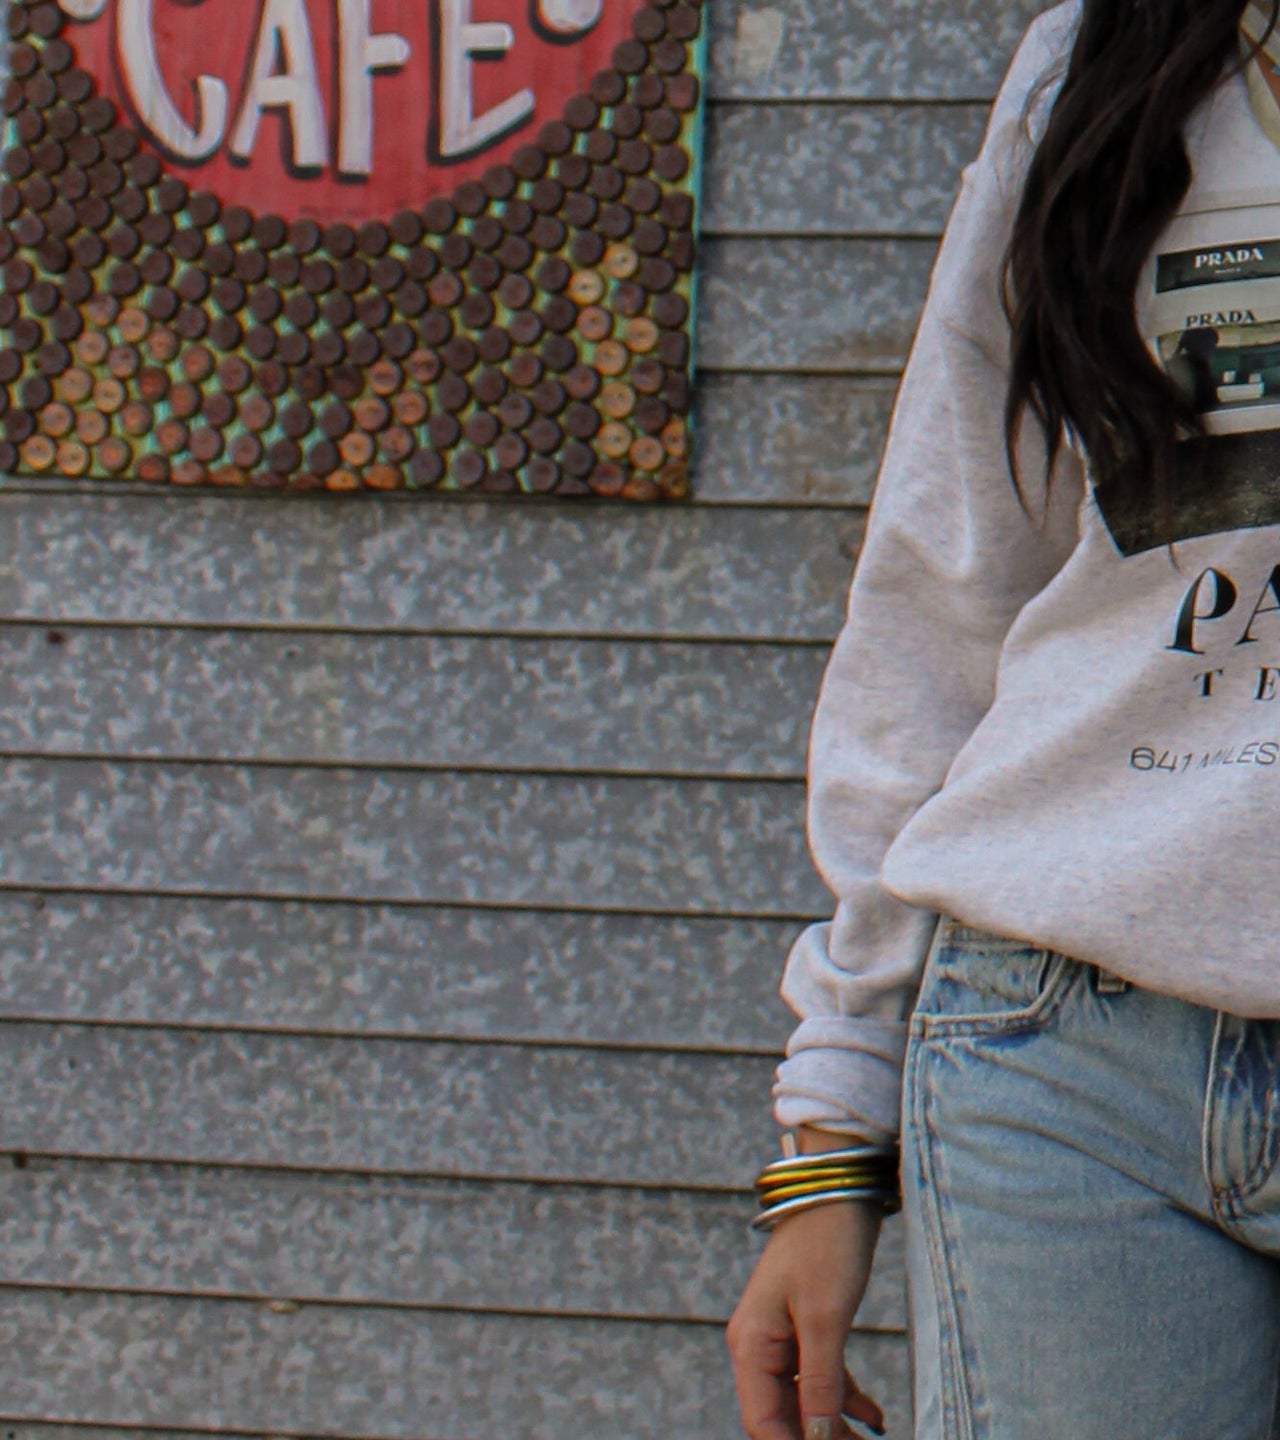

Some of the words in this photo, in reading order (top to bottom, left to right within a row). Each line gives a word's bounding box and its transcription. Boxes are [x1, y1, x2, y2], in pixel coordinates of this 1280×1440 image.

[1194, 247, 1264, 268] PRADA
[1186, 308, 1258, 327] PRADA
[1199, 741, 1280, 770] MILES
